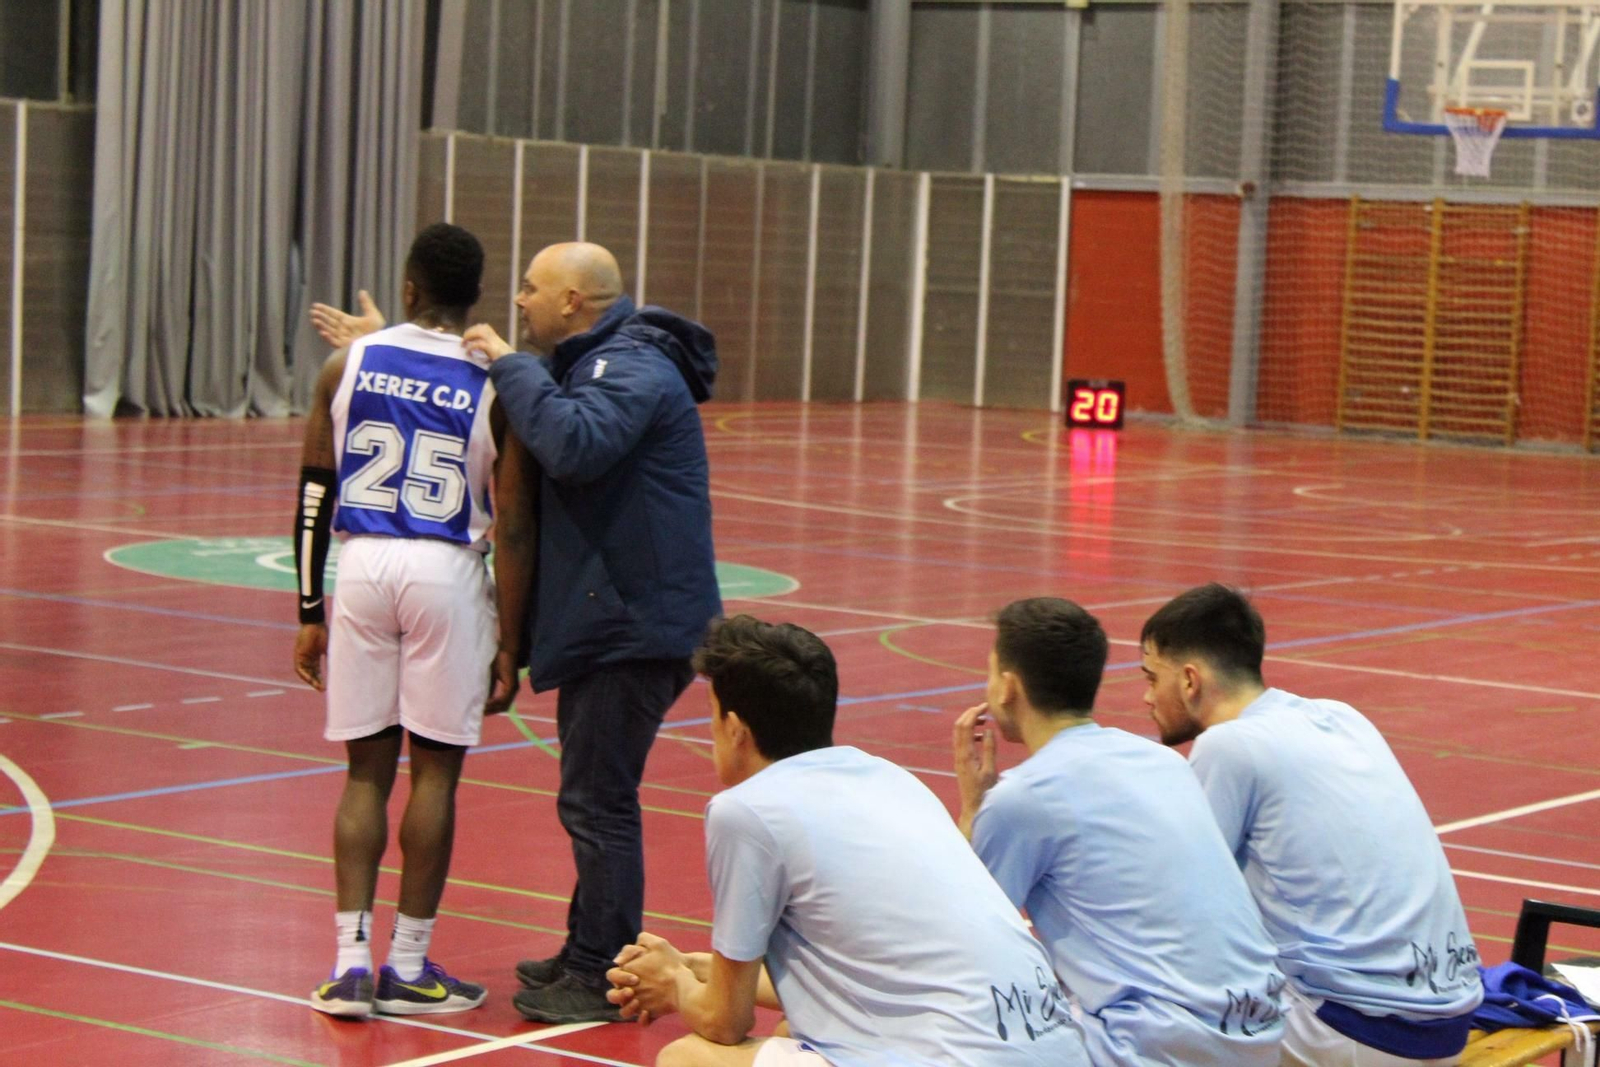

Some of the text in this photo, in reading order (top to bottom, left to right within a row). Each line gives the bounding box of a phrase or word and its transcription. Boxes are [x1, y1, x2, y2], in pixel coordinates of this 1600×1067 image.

[356, 371, 474, 414] XEREZ C.D.
[1071, 388, 1118, 423] 20
[340, 420, 467, 523] 25
